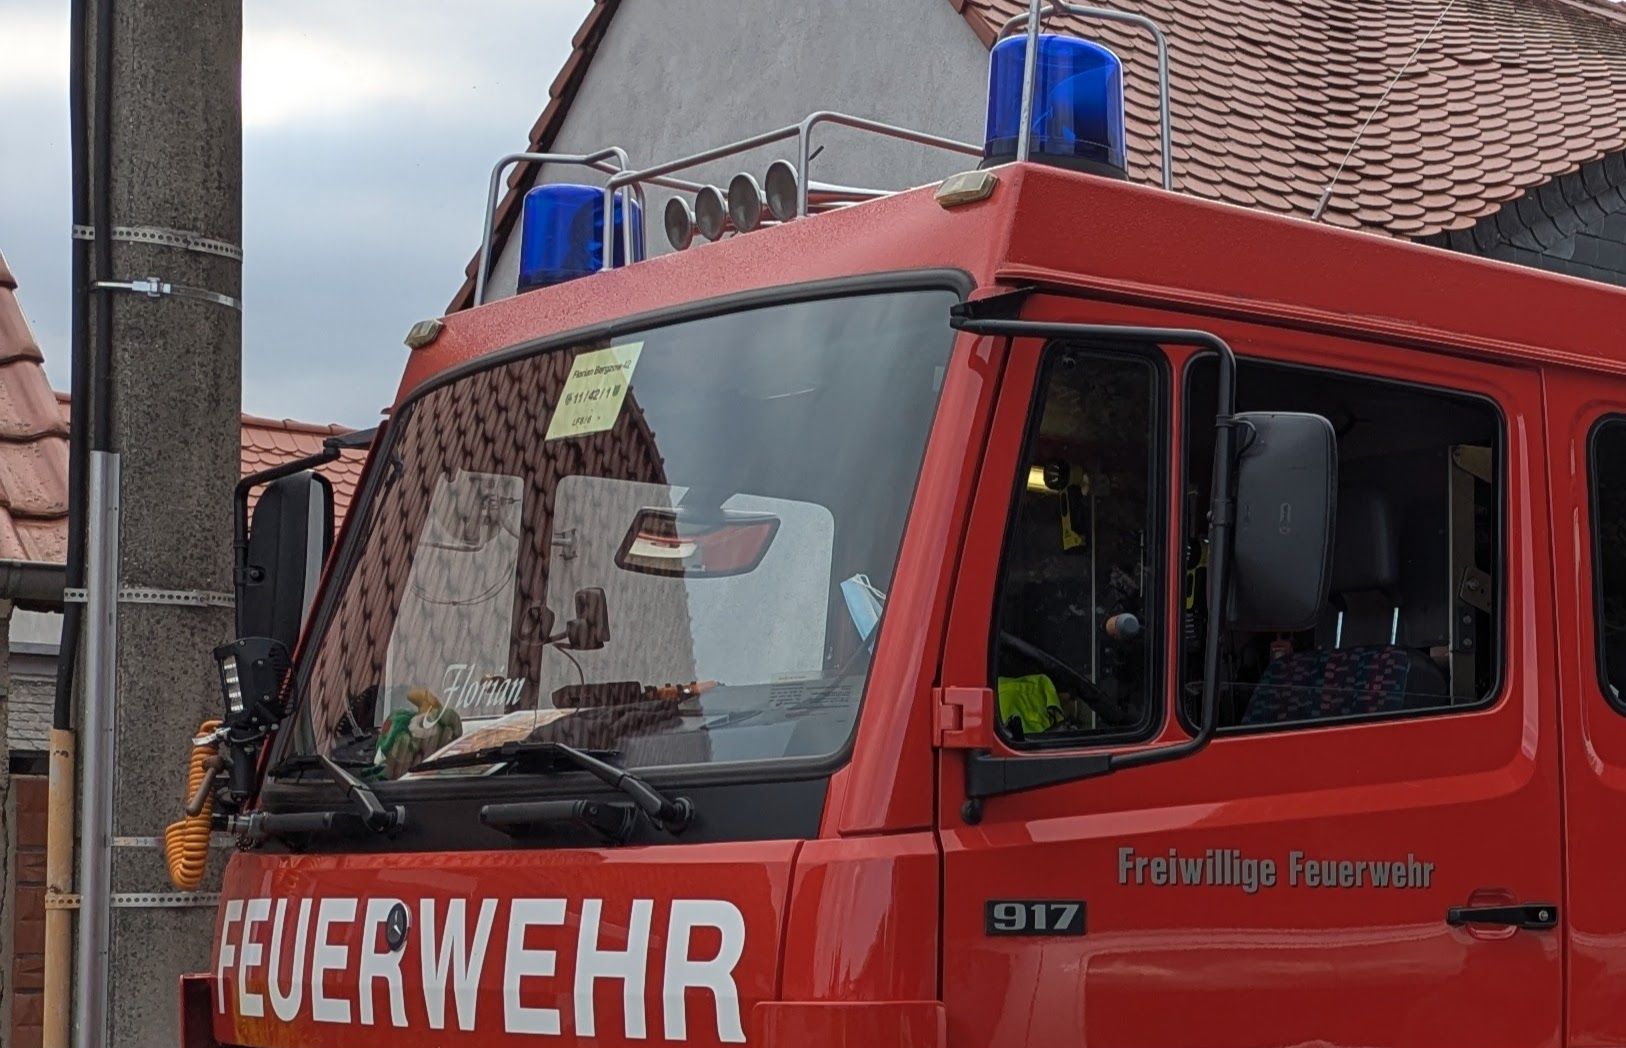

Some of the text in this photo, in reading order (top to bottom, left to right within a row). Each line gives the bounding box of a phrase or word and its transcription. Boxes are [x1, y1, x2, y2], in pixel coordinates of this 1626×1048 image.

[423, 664, 526, 729] Florian
[1117, 846, 1435, 893] Freiwillige Feuerwehr
[993, 903, 1079, 930] 917
[216, 897, 747, 1044] FEUERWEHR
